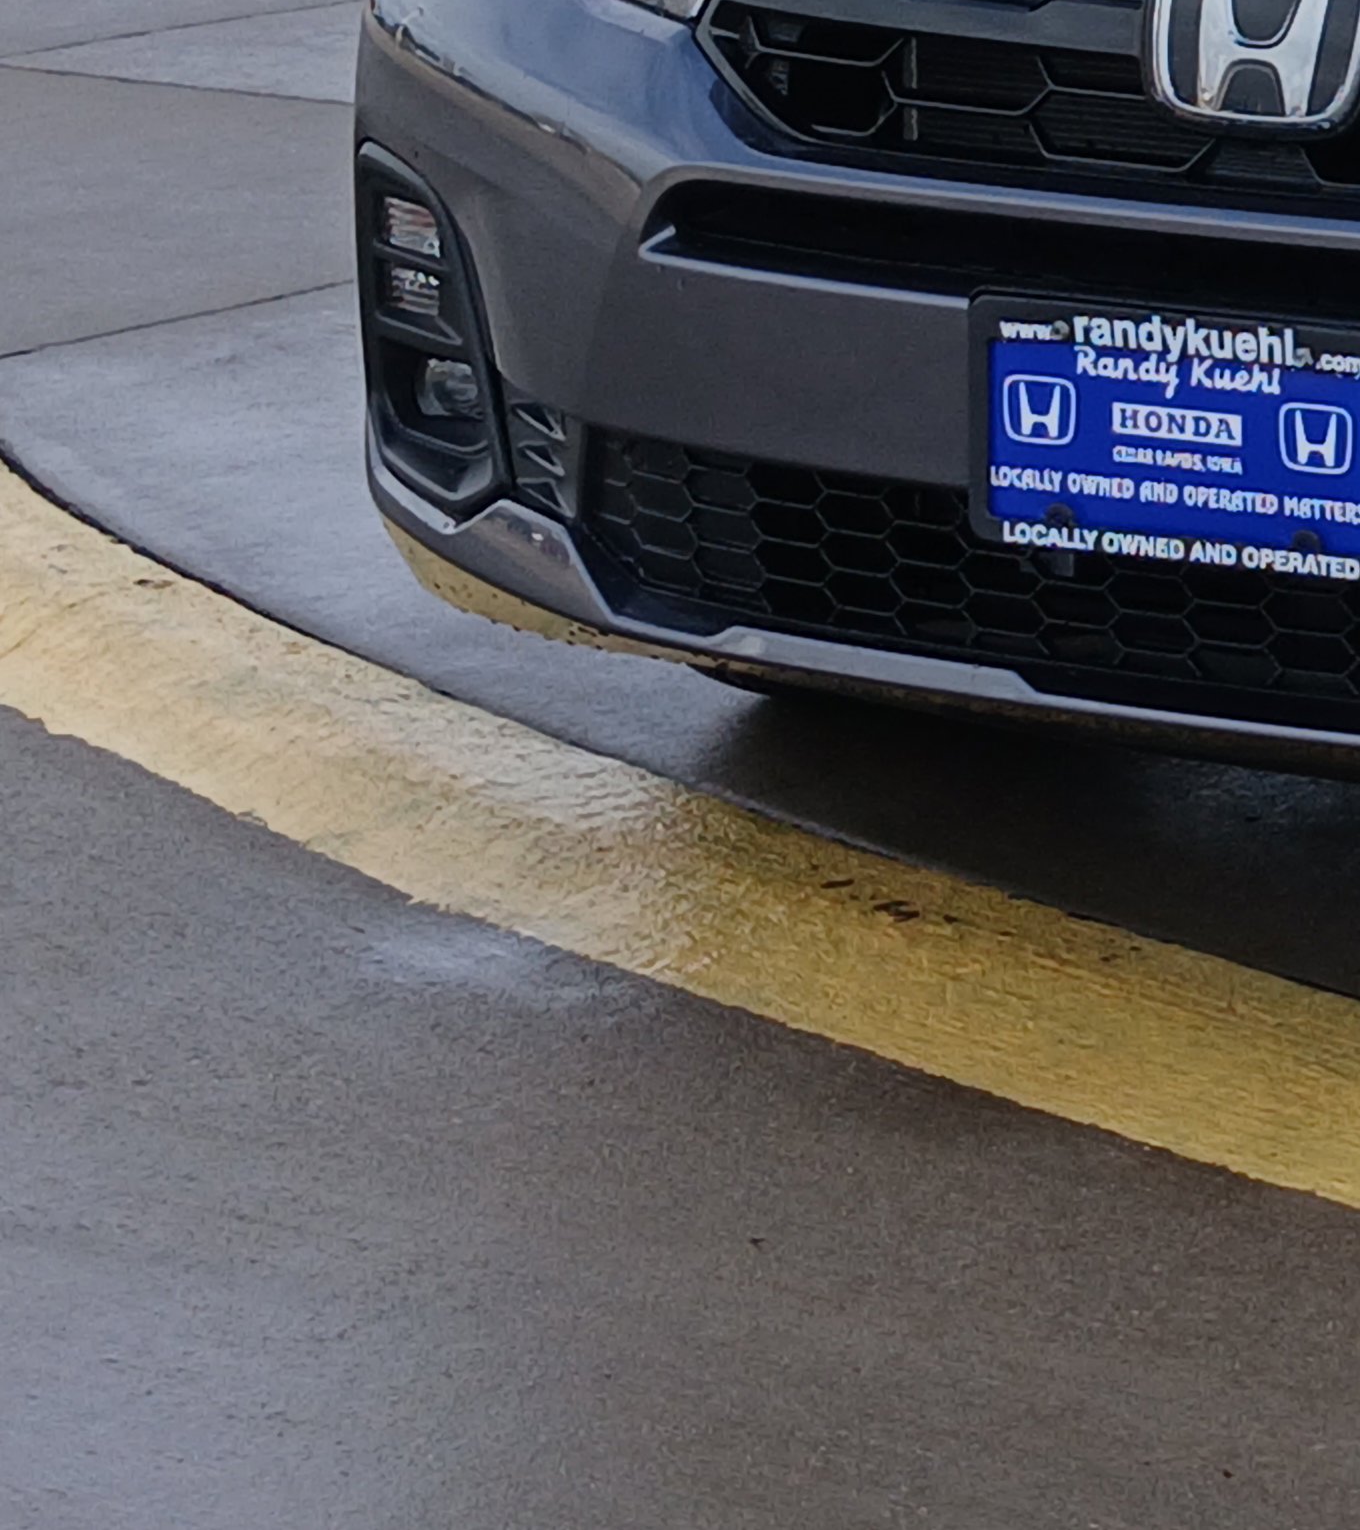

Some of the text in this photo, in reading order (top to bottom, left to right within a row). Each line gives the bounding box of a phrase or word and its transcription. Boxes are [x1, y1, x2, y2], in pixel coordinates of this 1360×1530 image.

[1074, 346, 1282, 399] Randy Kuehl
[1120, 407, 1237, 441] HONDA
[990, 465, 1062, 492] LOCALLY
[1067, 473, 1135, 499] OWNED
[1139, 480, 1179, 504] AND
[1183, 484, 1279, 515] OPERATED
[1003, 521, 1360, 581] LOCALLY OWNED AND OPERATED
